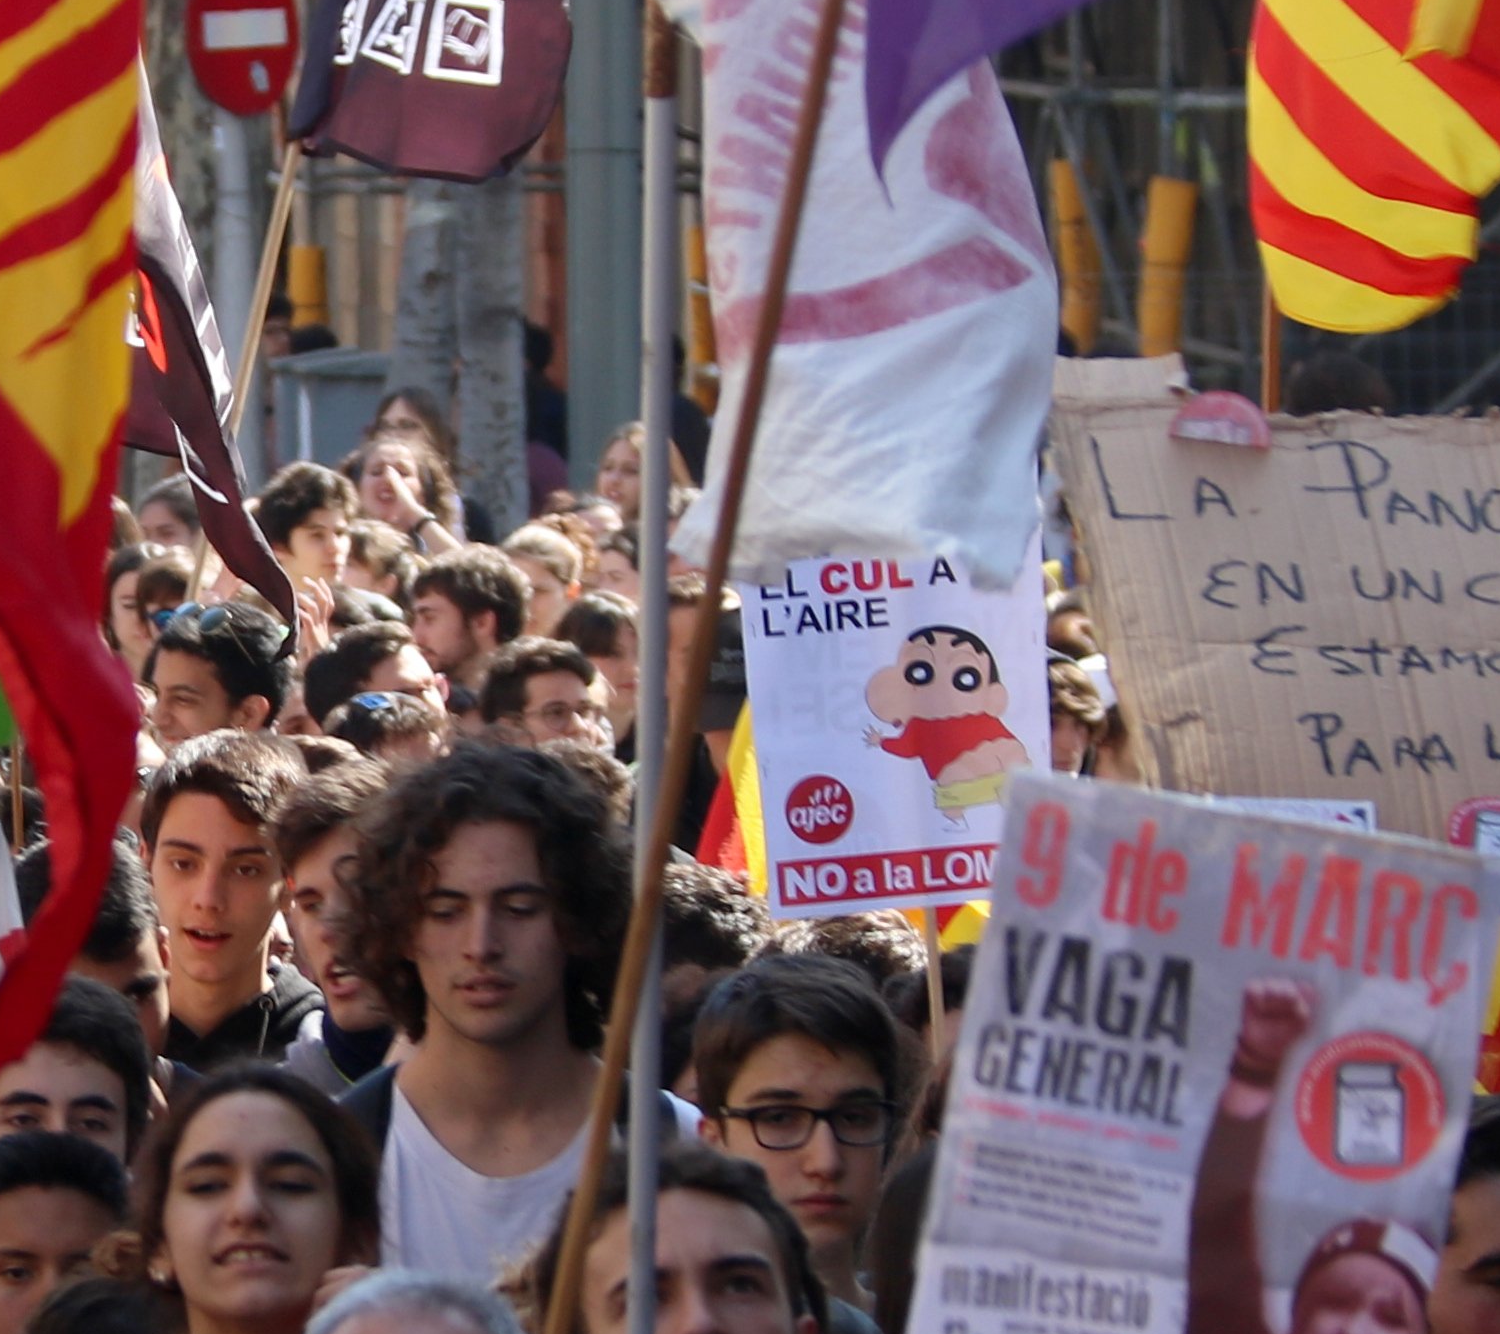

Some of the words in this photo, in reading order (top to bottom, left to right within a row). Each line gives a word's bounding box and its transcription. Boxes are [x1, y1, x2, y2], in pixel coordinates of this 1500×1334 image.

[818, 558, 914, 595] CUL
[928, 555, 957, 586] A
[1201, 560, 1307, 610] EN
[1351, 561, 1444, 604] UN
[762, 597, 890, 637] L'AIRE
[783, 861, 849, 899] NO
[853, 867, 877, 894] a
[883, 858, 914, 889] la
[1016, 801, 1071, 909] 9
[1101, 817, 1189, 934] de
[1218, 842, 1479, 1008] MARÇ
[1005, 926, 1194, 1049] VAGA
[973, 1019, 1184, 1128] GENERAL
